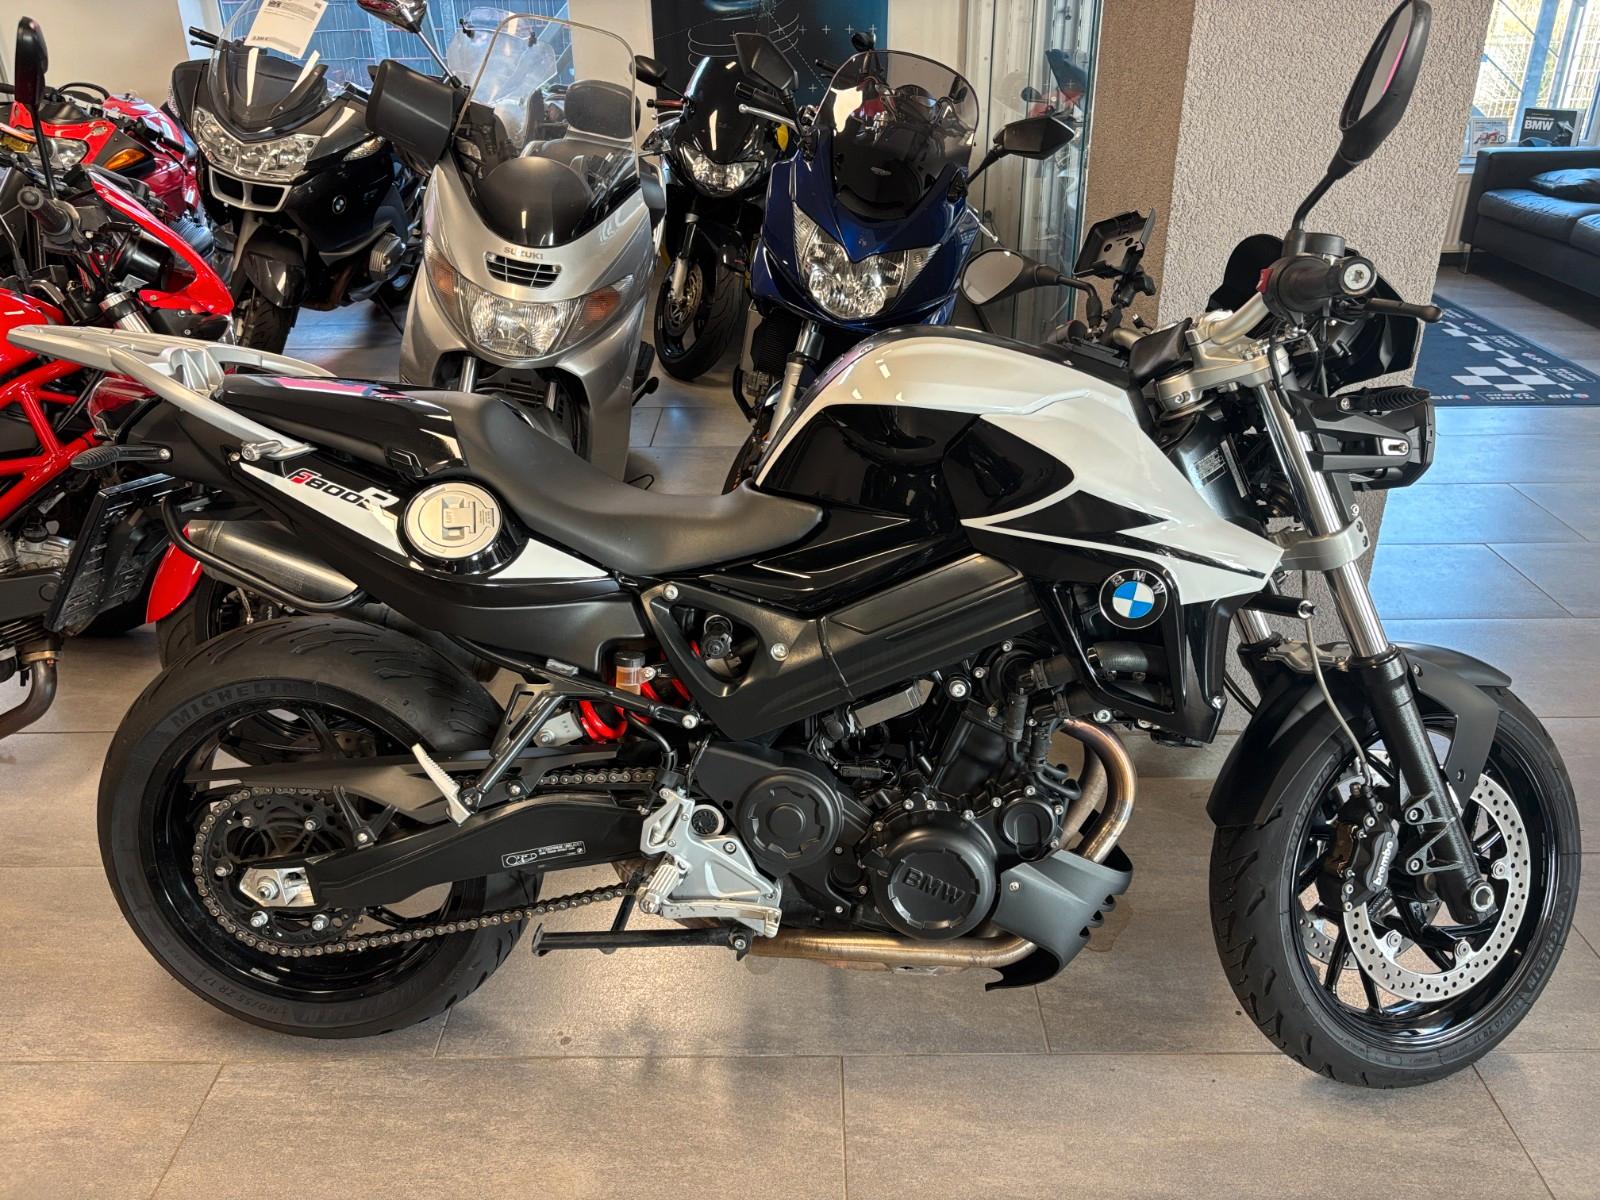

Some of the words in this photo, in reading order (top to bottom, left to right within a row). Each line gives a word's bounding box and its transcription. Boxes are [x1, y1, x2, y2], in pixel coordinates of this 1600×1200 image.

[1524, 120, 1554, 131] BMW
[1110, 570, 1166, 595] BMW
[170, 682, 299, 728] MICHELIN
[1373, 841, 1393, 886] brembo
[903, 867, 966, 905] BMW
